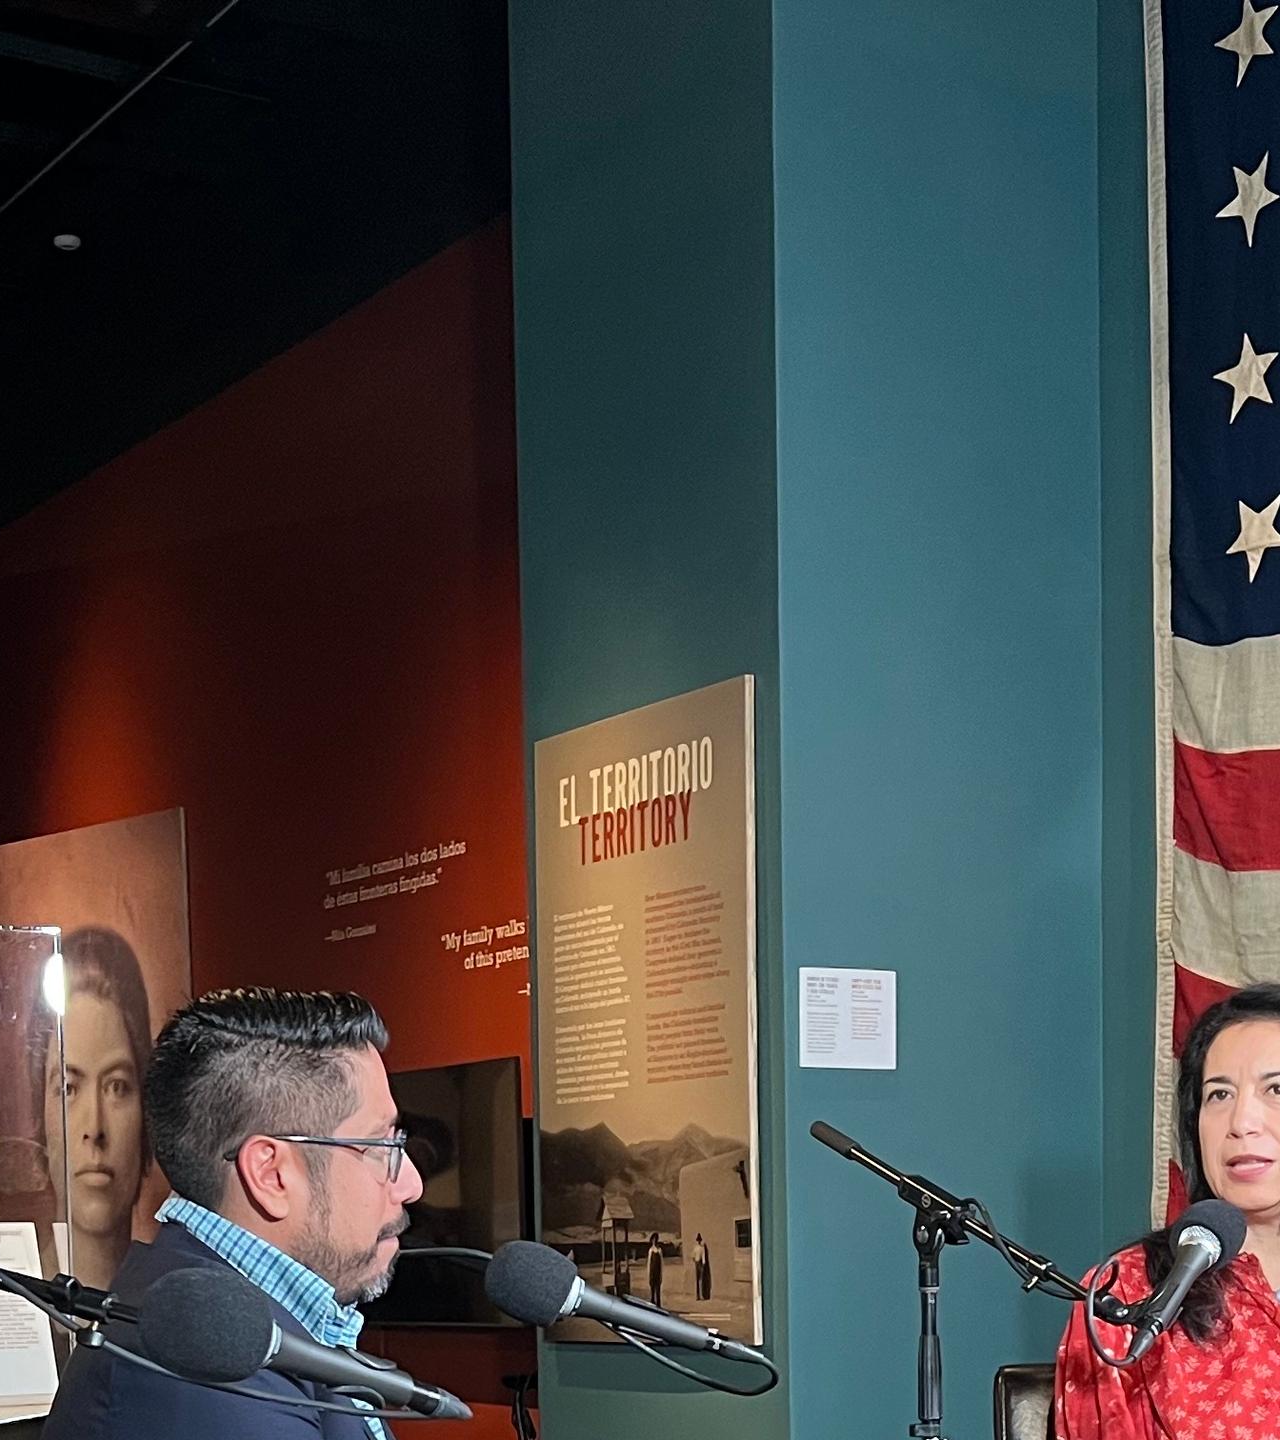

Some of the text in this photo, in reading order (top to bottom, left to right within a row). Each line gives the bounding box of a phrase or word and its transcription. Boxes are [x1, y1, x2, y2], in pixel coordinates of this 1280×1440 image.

[559, 736, 713, 828] EL TERRITORIO
[578, 788, 692, 866] TERRITORY
[405, 852, 418, 866] los
[420, 847, 437, 863] dos
[439, 840, 466, 859] lados
[323, 894, 335, 909] de
[463, 926, 493, 945] family
[496, 919, 525, 939] walks
[464, 945, 529, 969] of this preten
